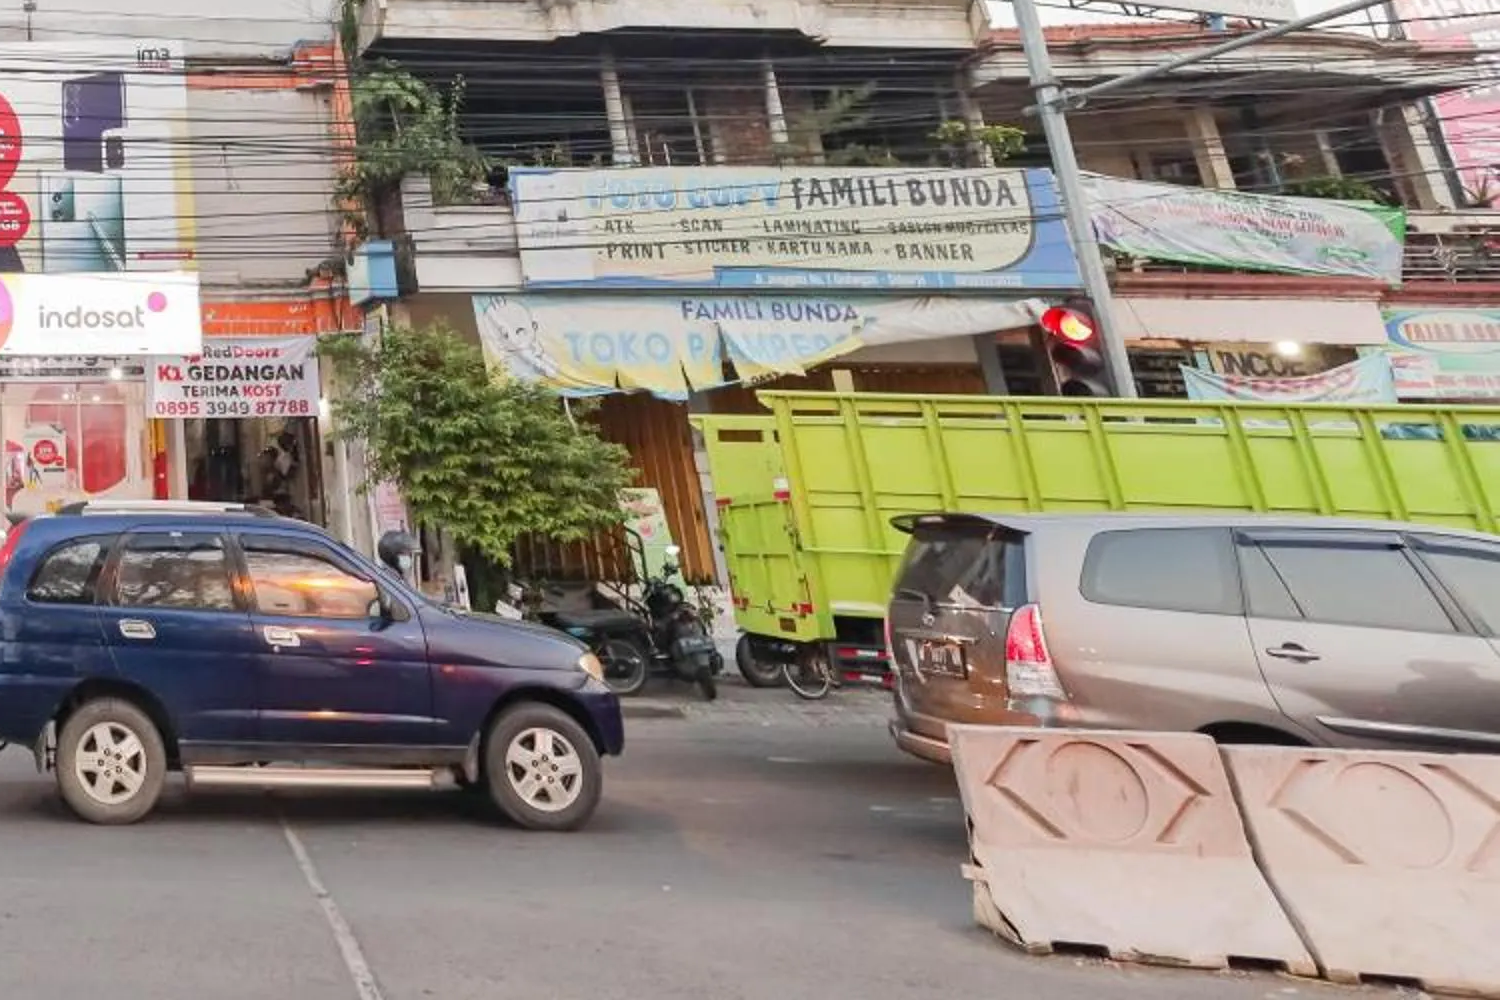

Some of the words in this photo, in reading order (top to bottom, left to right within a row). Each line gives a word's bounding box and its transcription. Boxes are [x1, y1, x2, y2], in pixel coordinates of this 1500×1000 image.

[792, 177, 899, 210] FAMILI
[907, 178, 1018, 207] BUNDA
[680, 219, 723, 233] SCAN
[763, 219, 861, 234] LAMINATING
[607, 244, 665, 261] PRINT
[895, 243, 975, 261] BANNER
[39, 304, 145, 329] indosat
[681, 300, 763, 320] FAMILI
[772, 301, 859, 323] BUNDA
[203, 346, 280, 359] RedDoorz
[563, 331, 674, 364] TOKO
[188, 365, 305, 381] GEDANGAN
[182, 385, 240, 398] TERIMA
[243, 385, 283, 398] KOST
[156, 401, 200, 415] 0895
[206, 401, 250, 415] 3949
[255, 400, 309, 414] 87788
